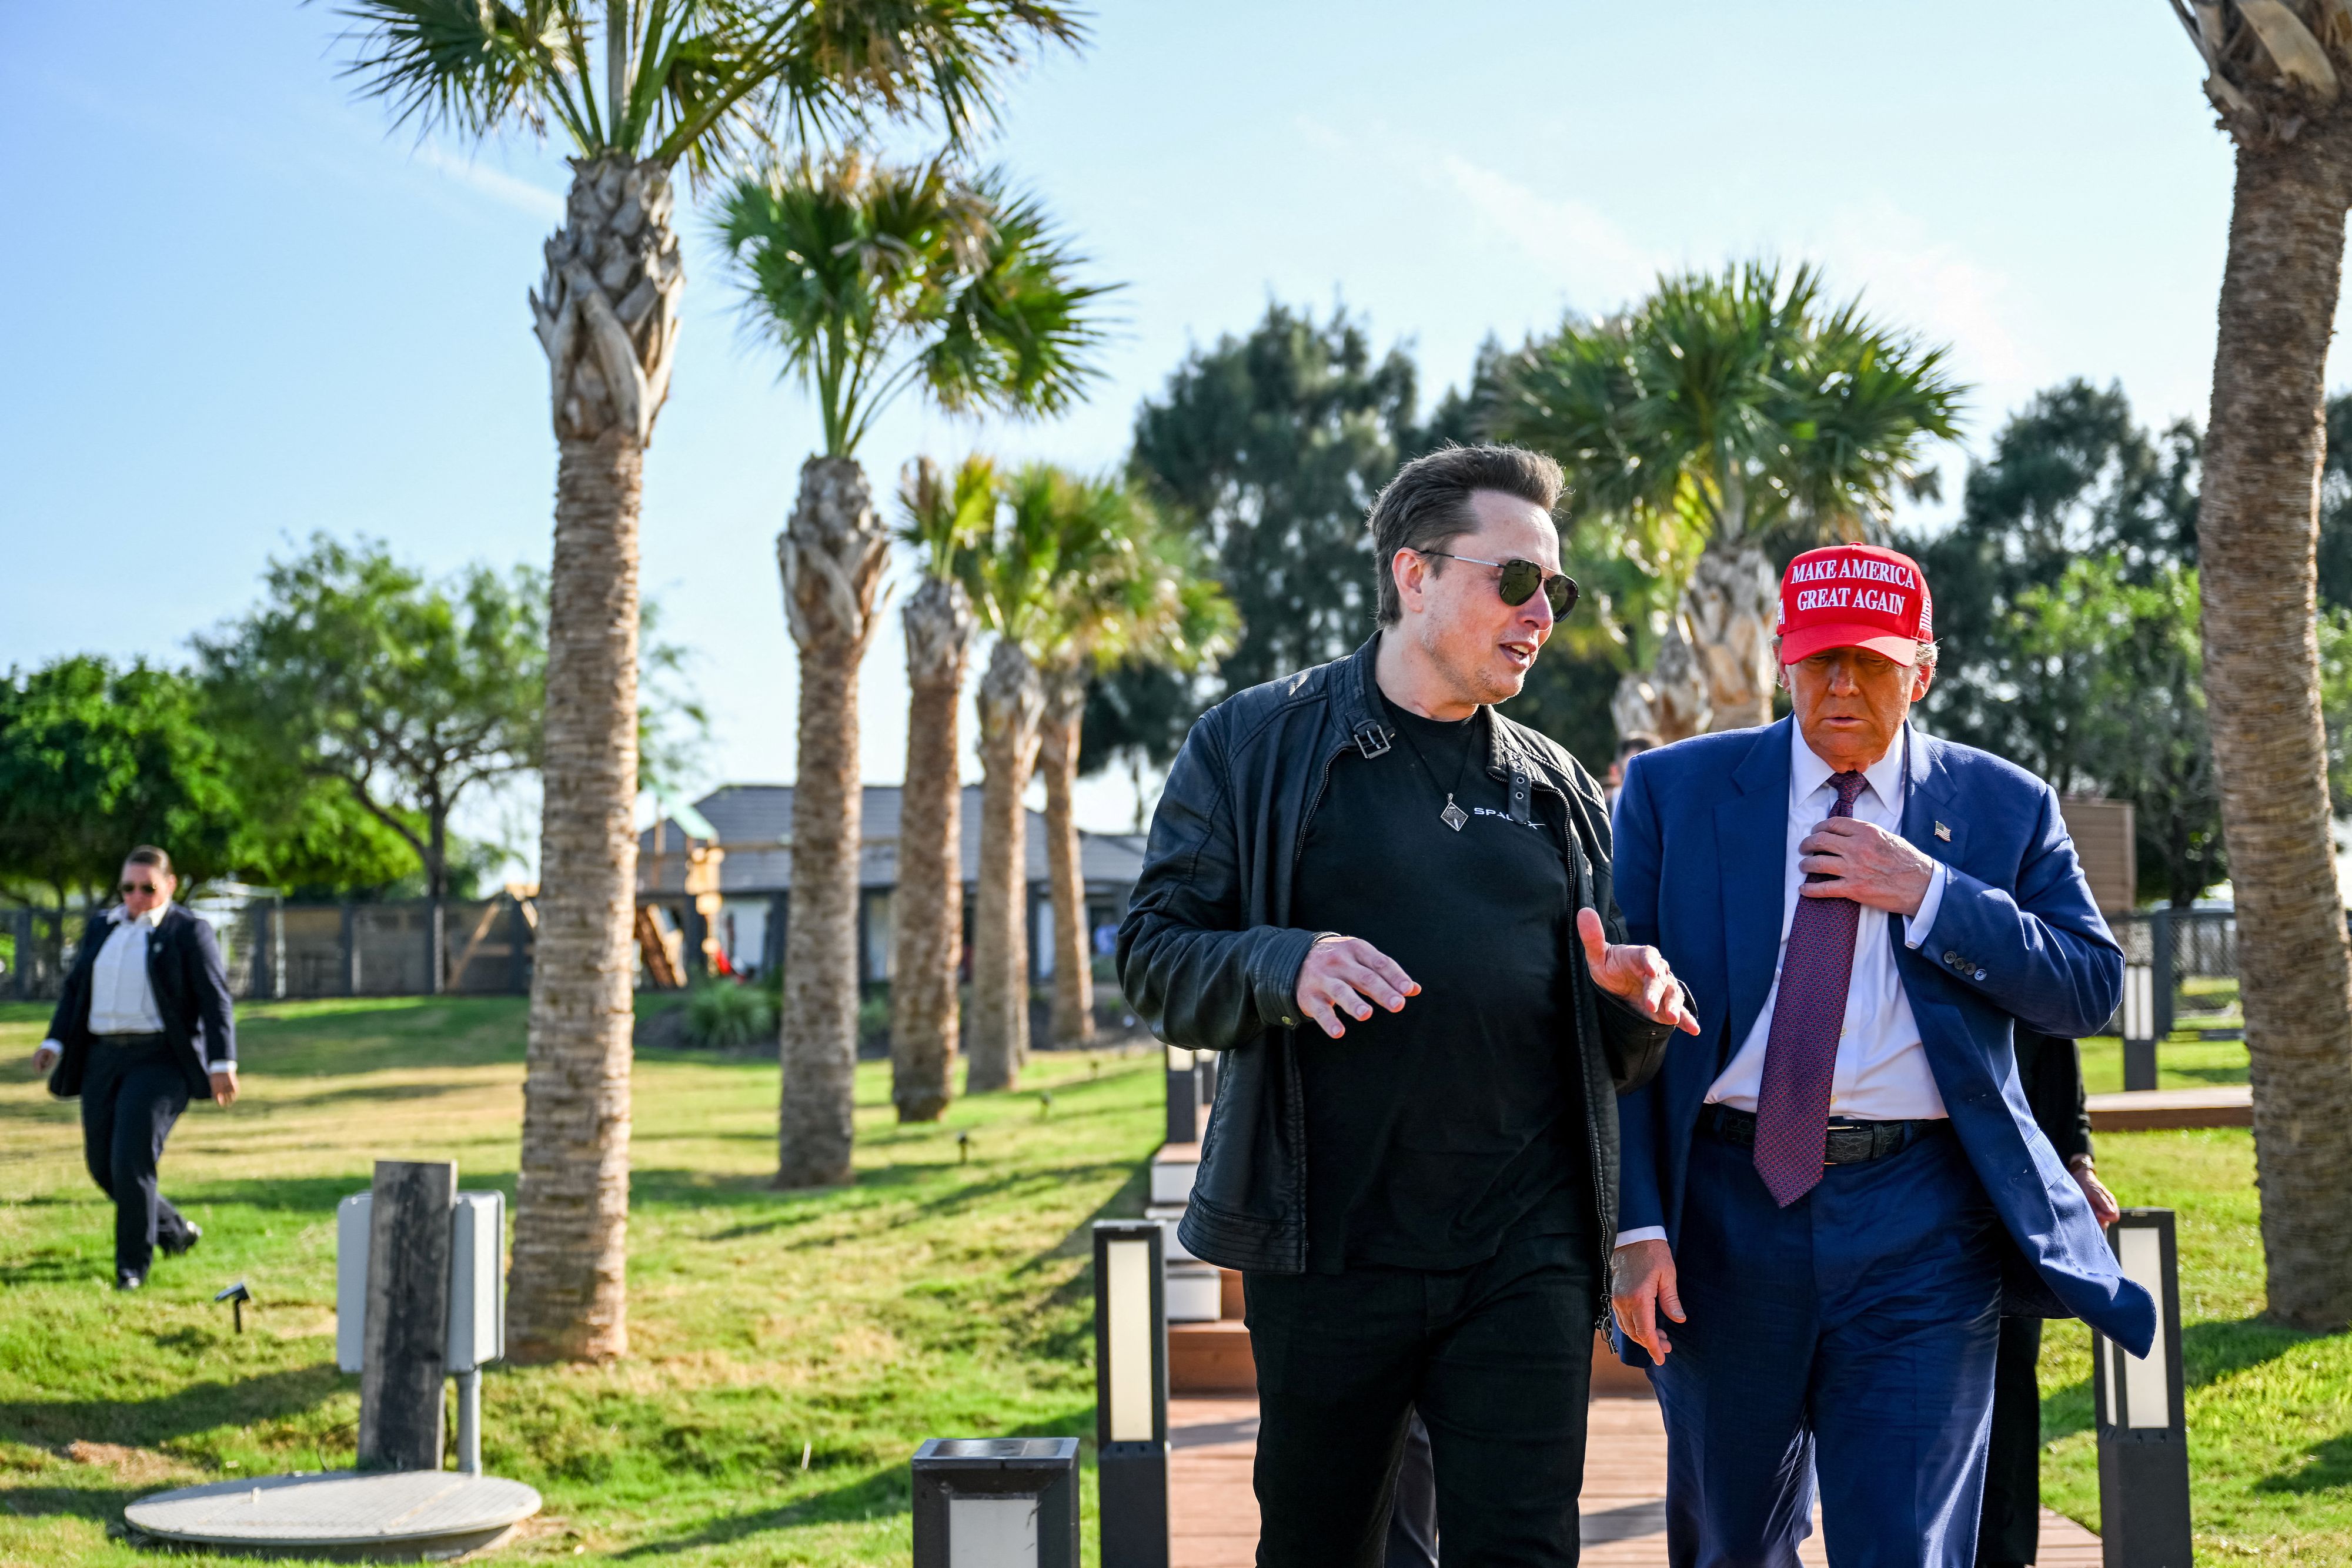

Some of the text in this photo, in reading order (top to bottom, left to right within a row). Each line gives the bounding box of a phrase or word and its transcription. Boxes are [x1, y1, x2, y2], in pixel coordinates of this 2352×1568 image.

[1790, 559, 1916, 590] MAKE AMERICA
[1797, 587, 1851, 611] GREAT
[1852, 588, 1906, 616] AGAIN
